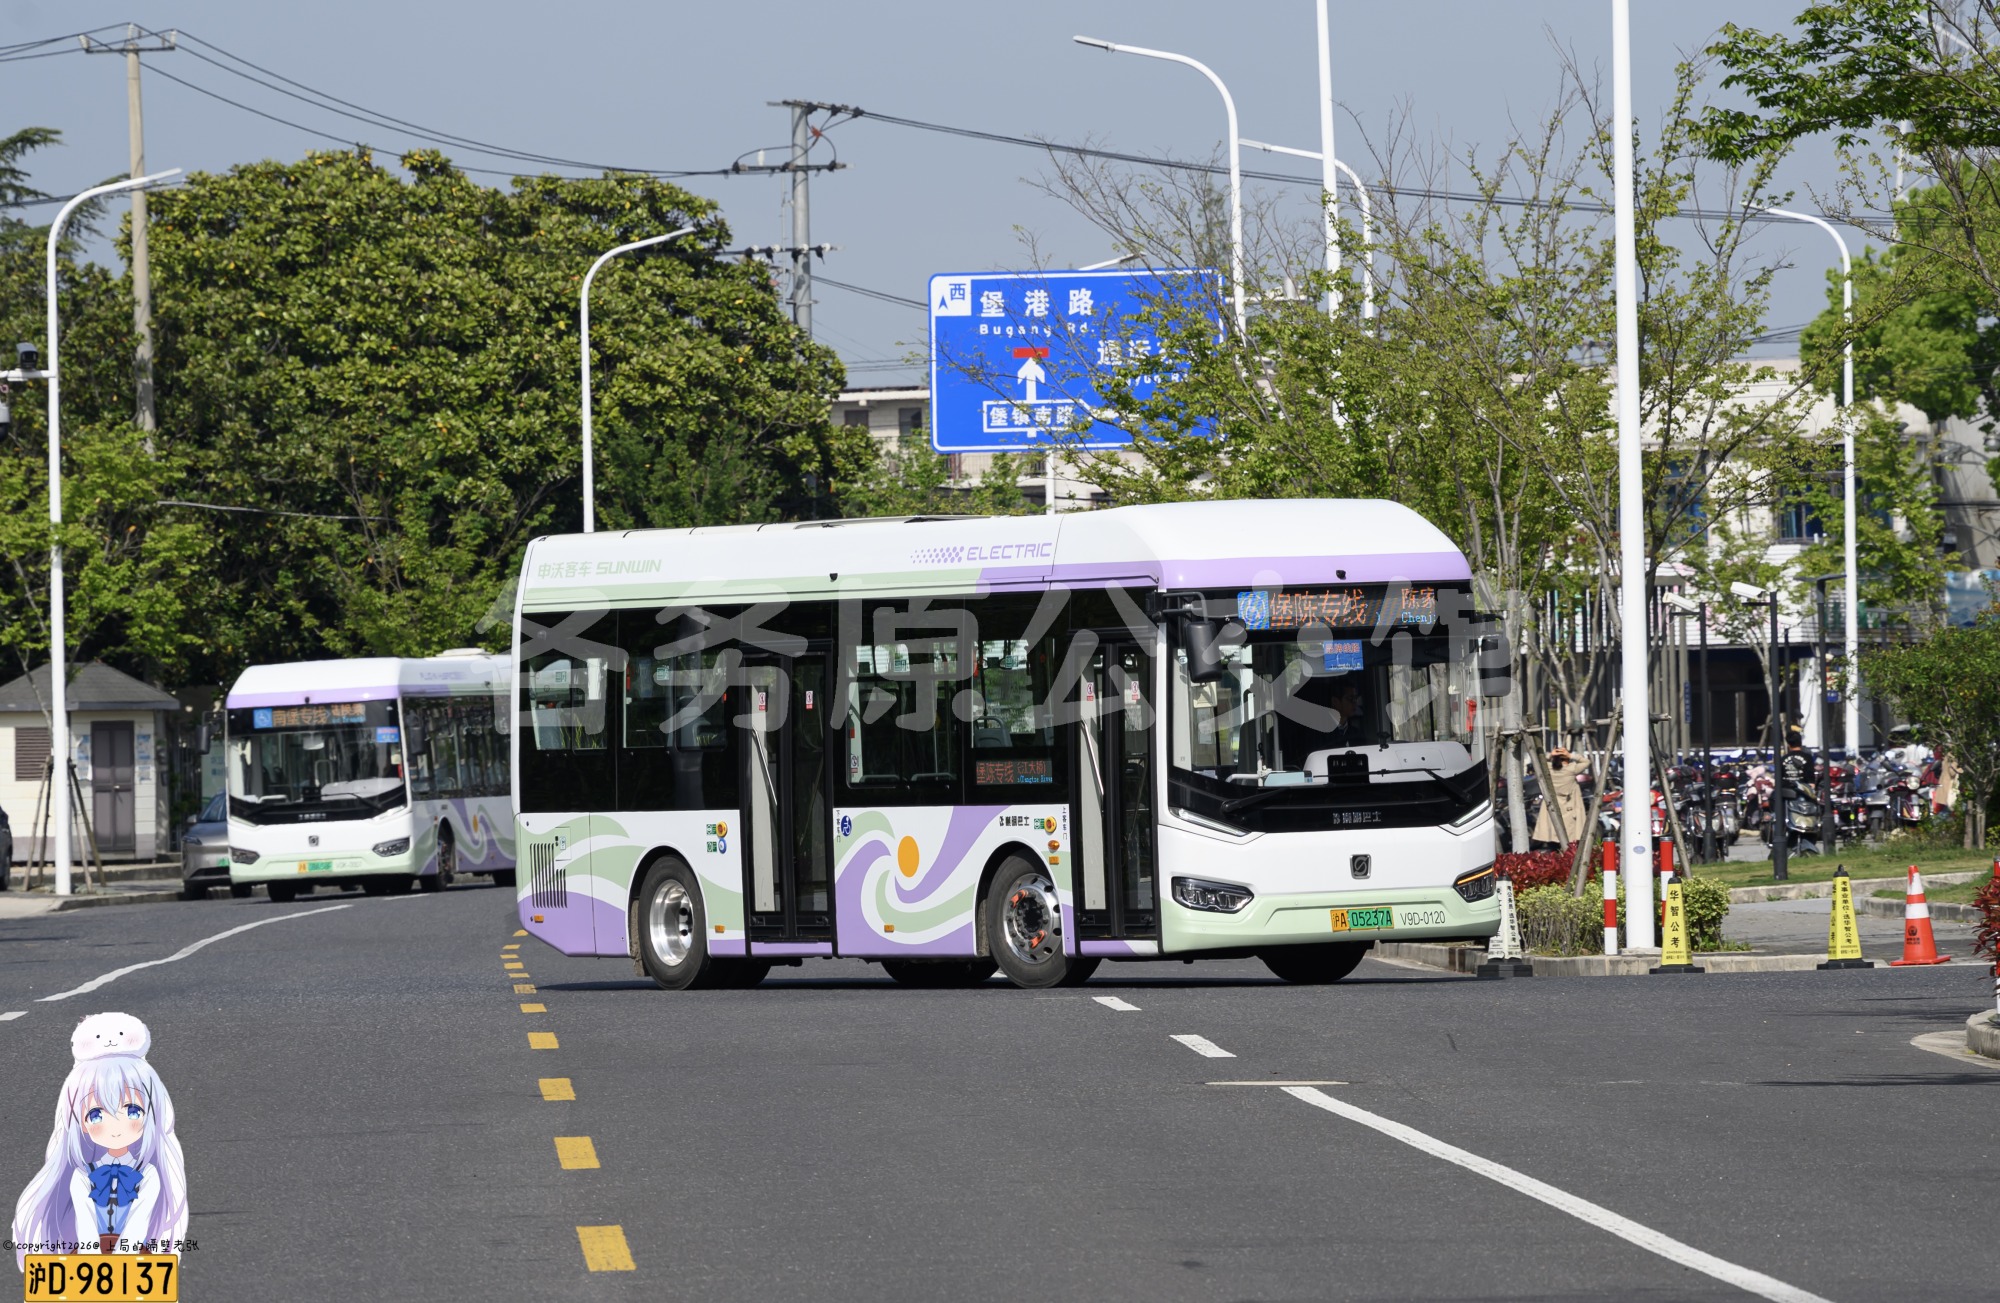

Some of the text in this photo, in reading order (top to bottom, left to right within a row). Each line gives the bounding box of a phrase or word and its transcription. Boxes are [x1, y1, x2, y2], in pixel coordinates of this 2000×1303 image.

[949, 283, 966, 301] 西
[980, 288, 1094, 317] 堡港路
[979, 323, 1052, 338] Bugang
[966, 542, 1053, 561] ELECTRIC
[537, 560, 662, 579] 申沃客车 SUNWIN
[1270, 588, 1369, 627] 堡陈专线
[1401, 587, 1436, 610] 陈家
[1400, 910, 1446, 926] V9D-0120
[1669, 889, 1681, 949] 华智公考
